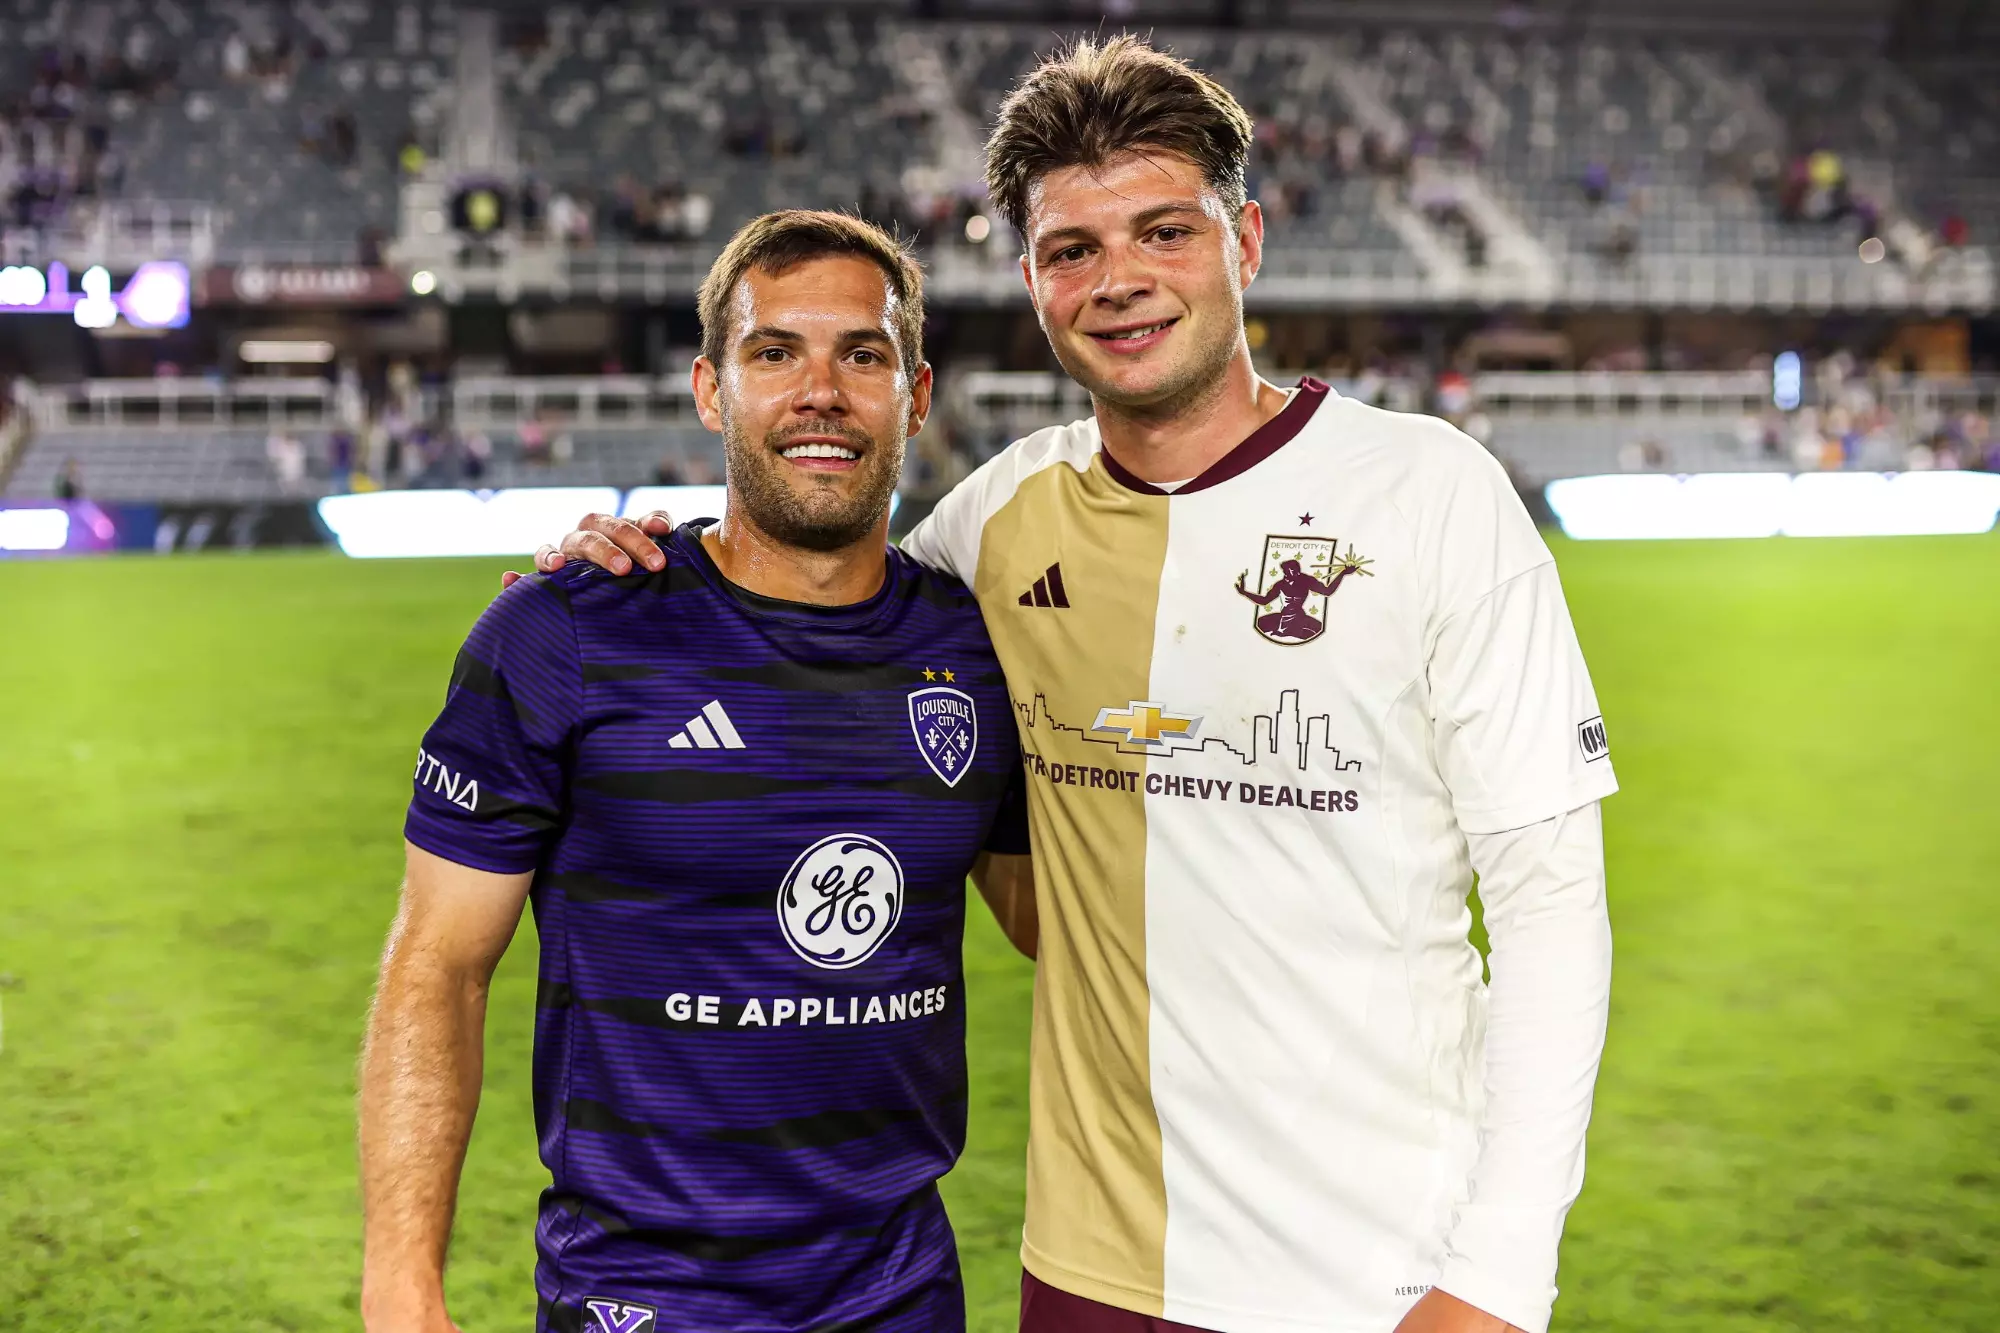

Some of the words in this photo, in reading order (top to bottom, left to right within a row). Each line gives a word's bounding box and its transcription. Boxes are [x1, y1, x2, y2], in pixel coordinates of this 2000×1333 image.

[1270, 541, 1302, 550] DETROIT
[1302, 542, 1319, 550] CITY
[917, 699, 971, 723] LOUISVILLE
[938, 716, 955, 726] CITY
[1051, 762, 1140, 792] DETROIT
[1145, 773, 1232, 801] CHEVY
[1239, 782, 1359, 812] DEALERS
[805, 865, 876, 936] GE
[665, 992, 720, 1025] GE
[737, 985, 947, 1027] APPLIANCES
[1394, 1284, 1431, 1296] AERORE
